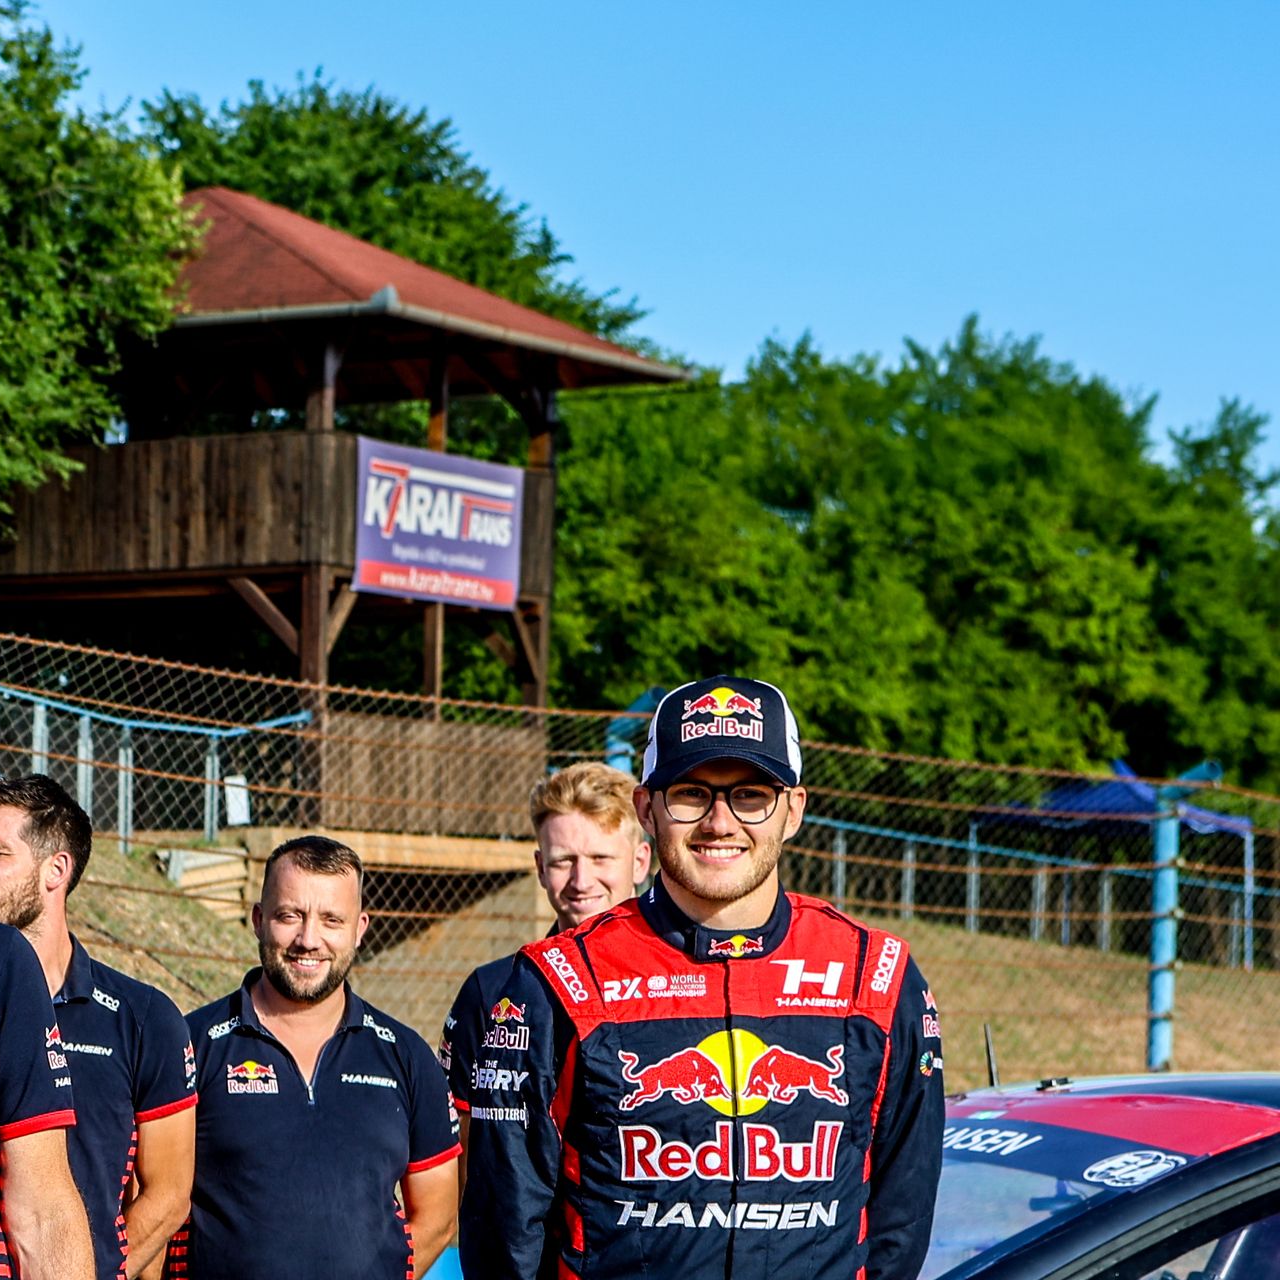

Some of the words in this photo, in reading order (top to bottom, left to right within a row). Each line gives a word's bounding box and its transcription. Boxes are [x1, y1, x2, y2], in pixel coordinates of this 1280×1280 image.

[681, 716, 720, 742] Red
[721, 717, 763, 742] Bull
[542, 947, 588, 1004] sparco
[870, 937, 901, 994] sparco
[603, 977, 643, 1002] RX
[670, 975, 705, 984] WORLD
[648, 989, 707, 998] CHAMPIONSHIP
[775, 997, 849, 1008] HANSEN
[499, 1026, 530, 1051] Bull
[227, 1079, 256, 1095] Red
[256, 1079, 279, 1094] Bull
[340, 1073, 398, 1089] HANSEN
[617, 1120, 735, 1182] Red
[742, 1120, 844, 1182] Bull
[613, 1200, 840, 1230] HANSEN
